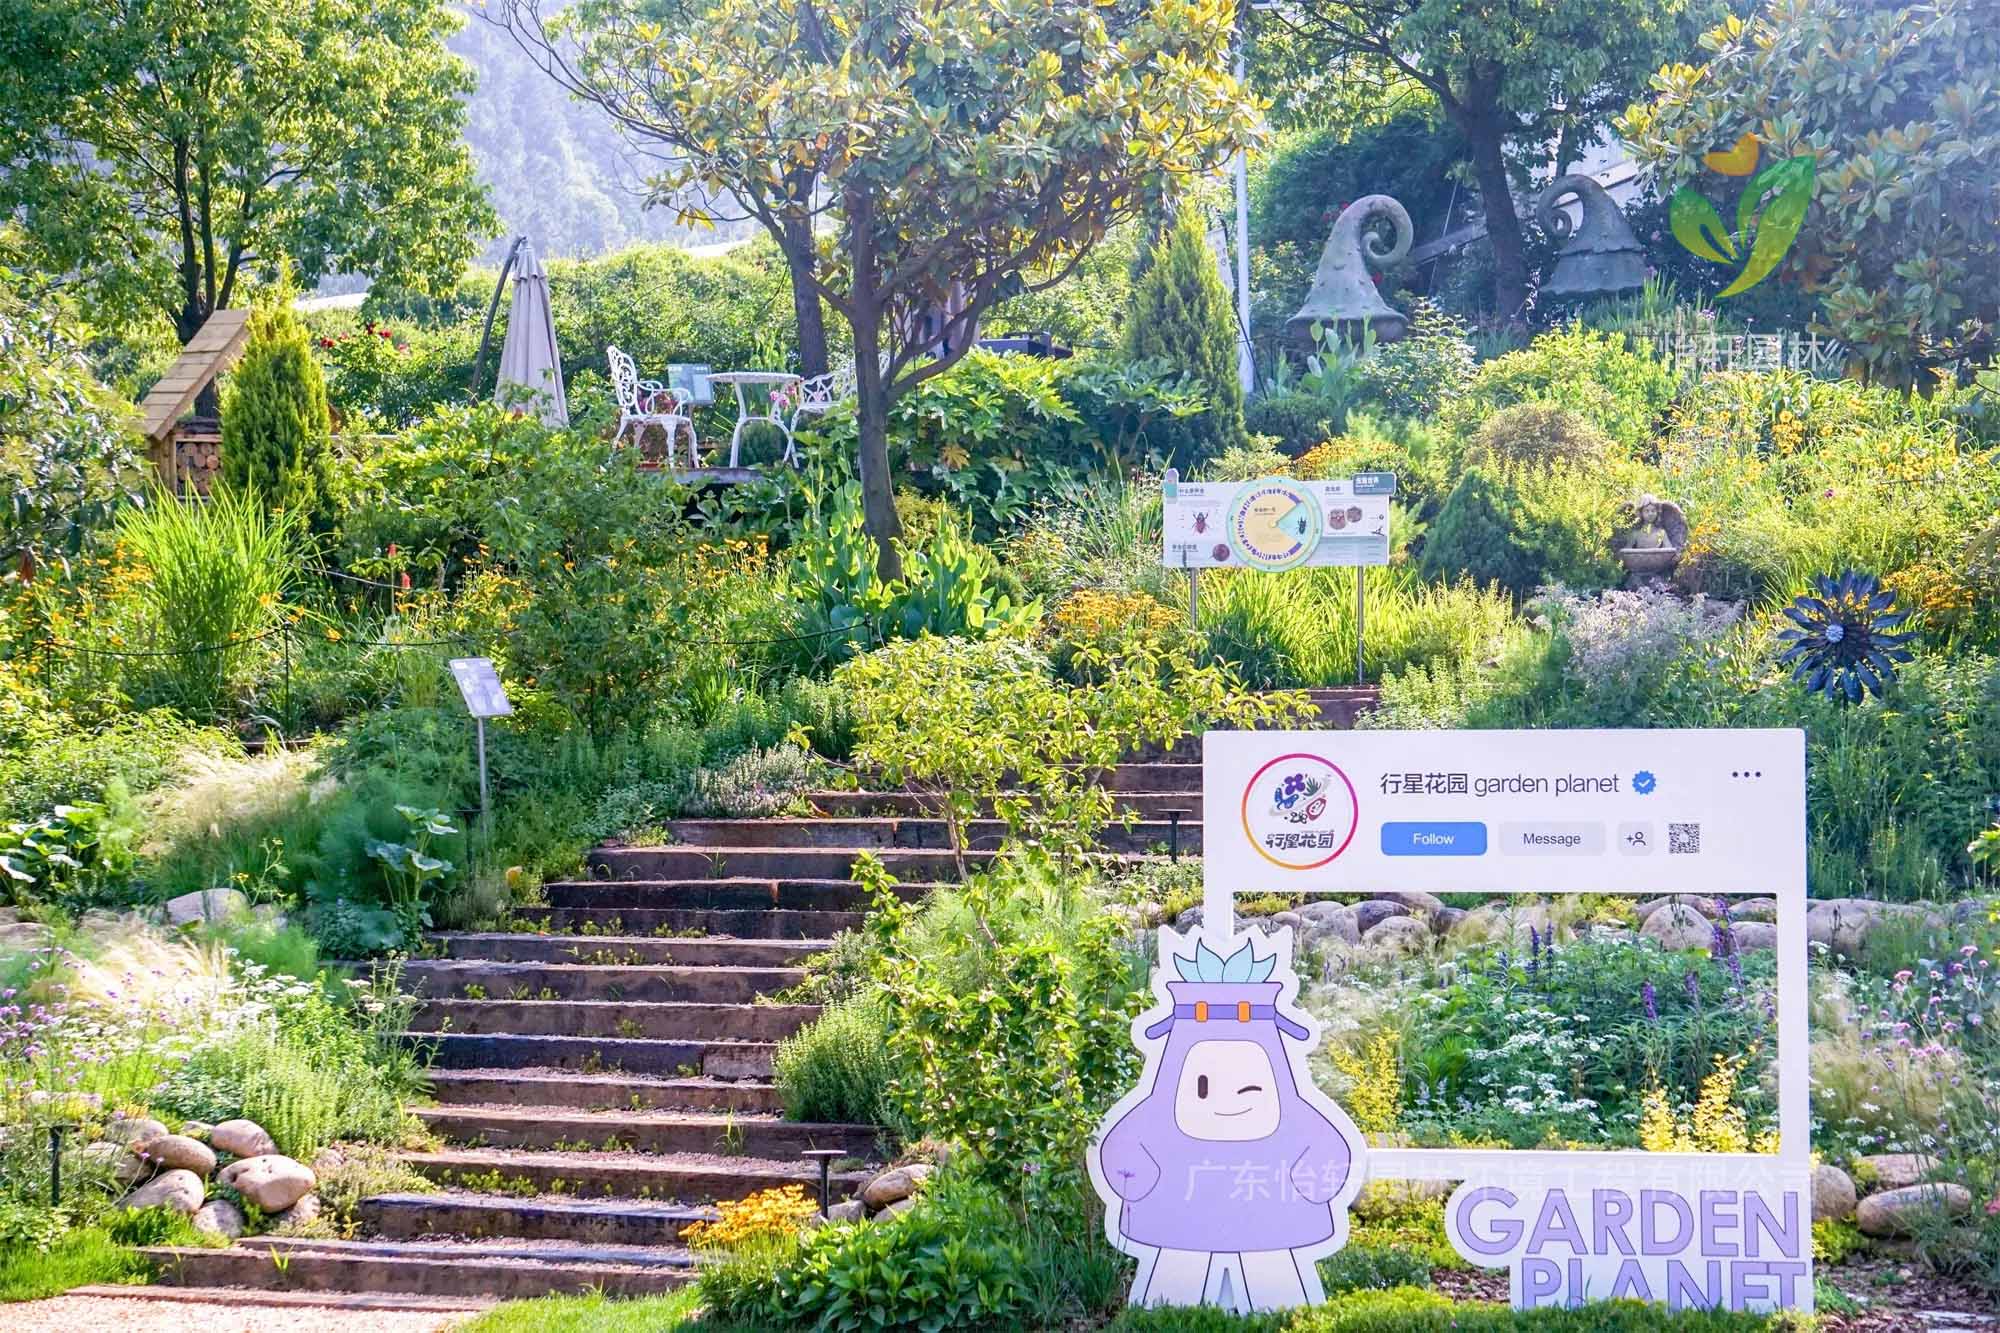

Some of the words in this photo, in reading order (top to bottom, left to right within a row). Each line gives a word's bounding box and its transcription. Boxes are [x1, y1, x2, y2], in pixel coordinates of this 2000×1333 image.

[1380, 772, 1469, 795] 行星花园
[1473, 773, 1548, 798] garden
[1554, 773, 1620, 797] planet
[1266, 832, 1335, 850] 行星花园
[1412, 832, 1456, 846] Follow
[1522, 832, 1582, 846] Message
[1456, 1186, 1800, 1258] GARDEN
